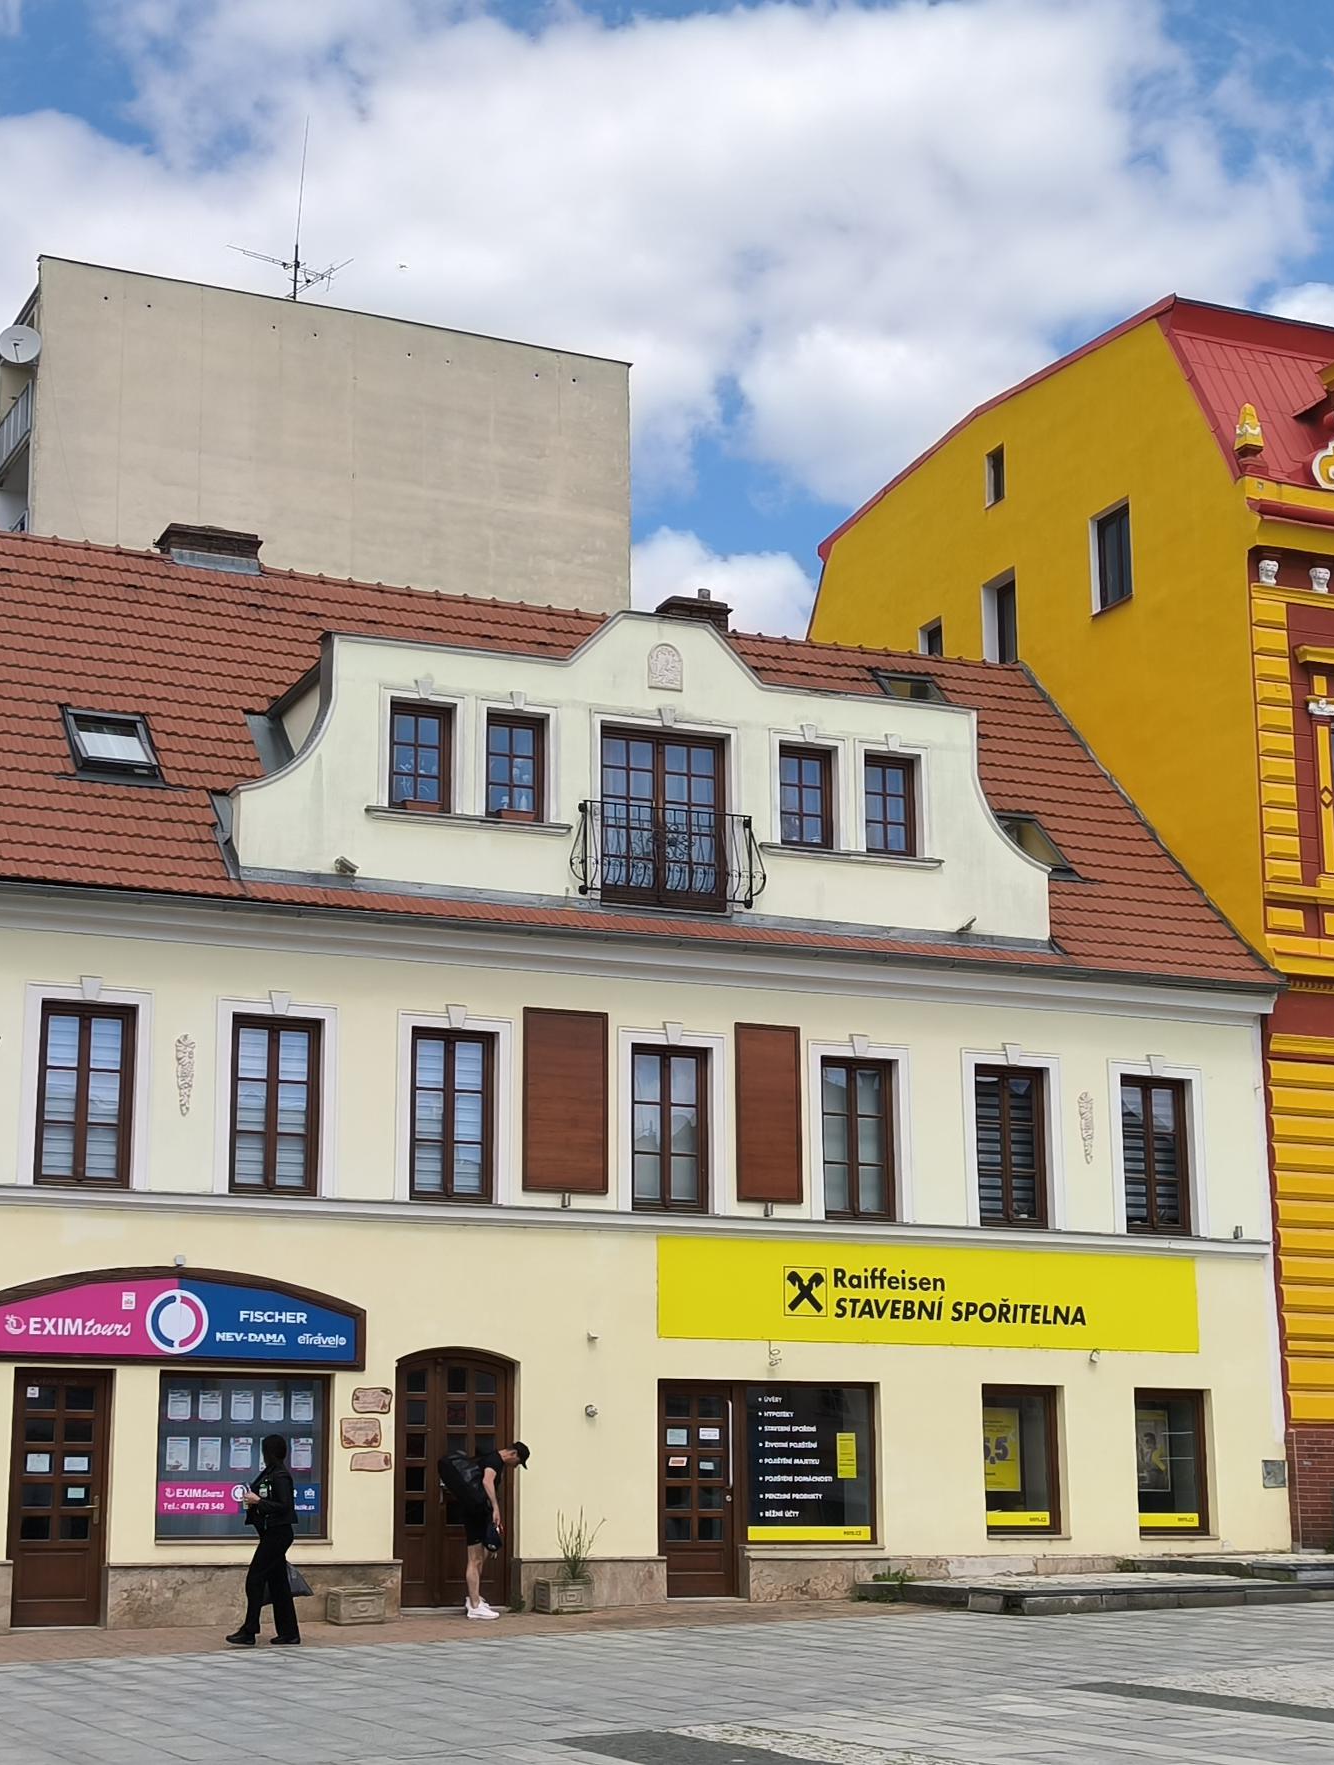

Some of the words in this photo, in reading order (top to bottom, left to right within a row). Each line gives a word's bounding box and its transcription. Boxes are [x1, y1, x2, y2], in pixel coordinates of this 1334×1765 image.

[833, 1267, 946, 1292] Raiffeisen
[239, 1310, 308, 1324] FISCHER
[834, 1296, 944, 1321] STAVEBNÍ
[950, 1298, 1087, 1326] SPOŘITELNA
[28, 1317, 132, 1337] EXIMtours
[215, 1332, 287, 1345] NEV-DAMA
